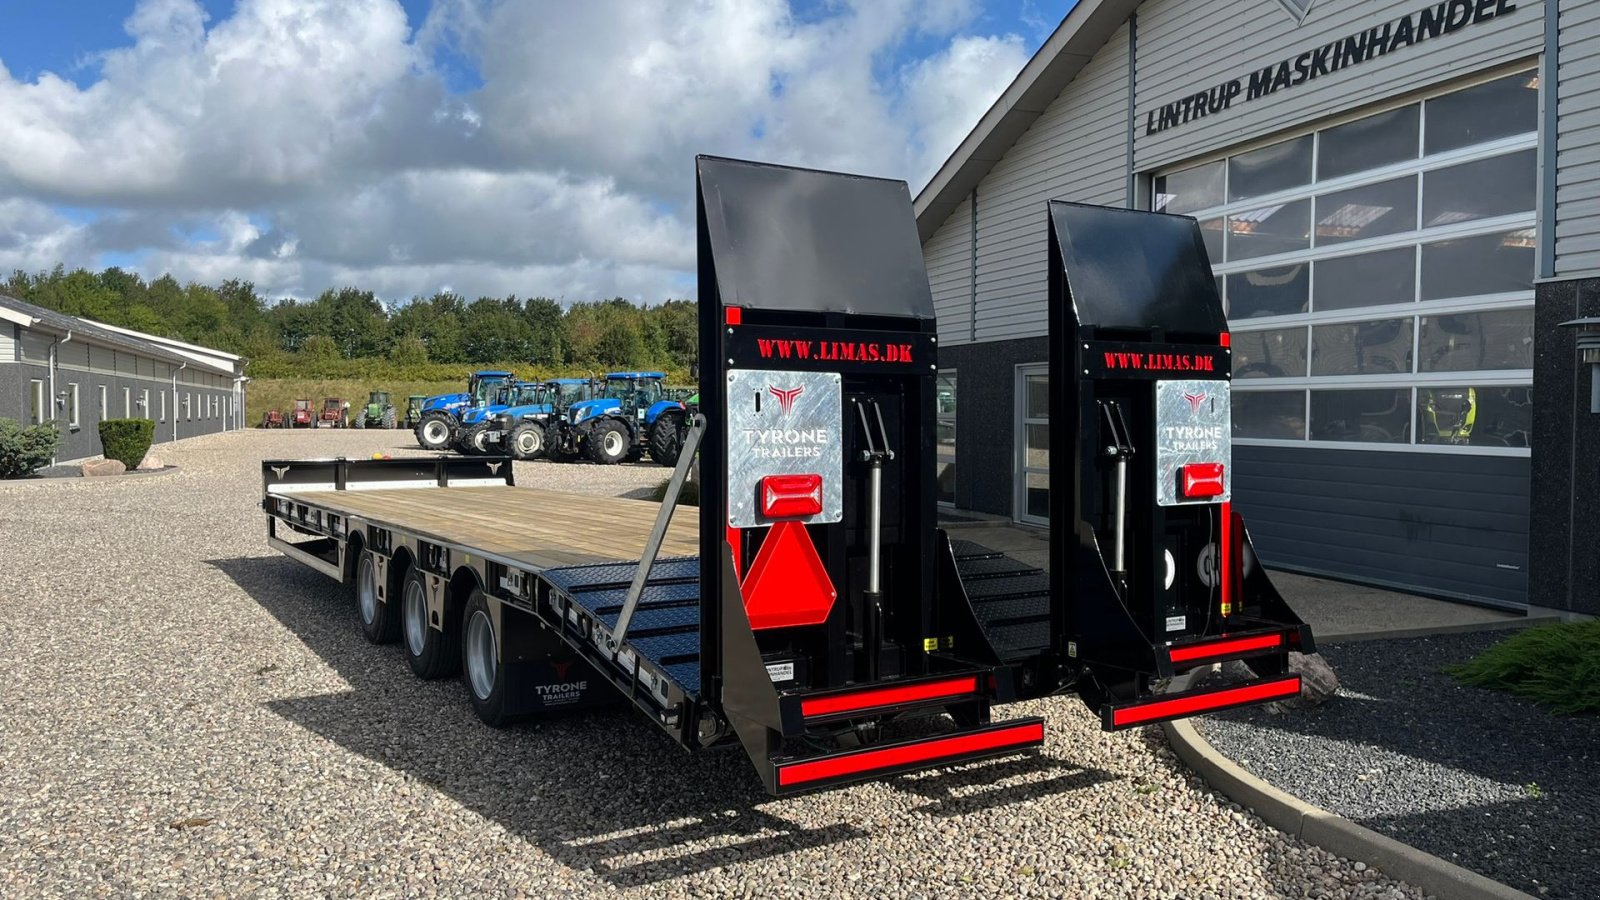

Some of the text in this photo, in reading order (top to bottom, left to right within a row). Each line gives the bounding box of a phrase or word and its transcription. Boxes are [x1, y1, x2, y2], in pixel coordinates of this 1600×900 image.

[1146, 0, 1517, 136] LINTRUP MASKINHANDEL
[757, 338, 913, 363] WWW.LIMAS.DK
[1104, 352, 1214, 371] WWW.LIMAS.DK
[742, 428, 828, 445] TYRONE
[1166, 426, 1222, 439] TYRONE
[751, 446, 821, 458] TRAILERS
[1173, 441, 1218, 451] TRAILERS
[535, 681, 587, 695] TYRONE
[542, 691, 581, 701] TRAILERS
